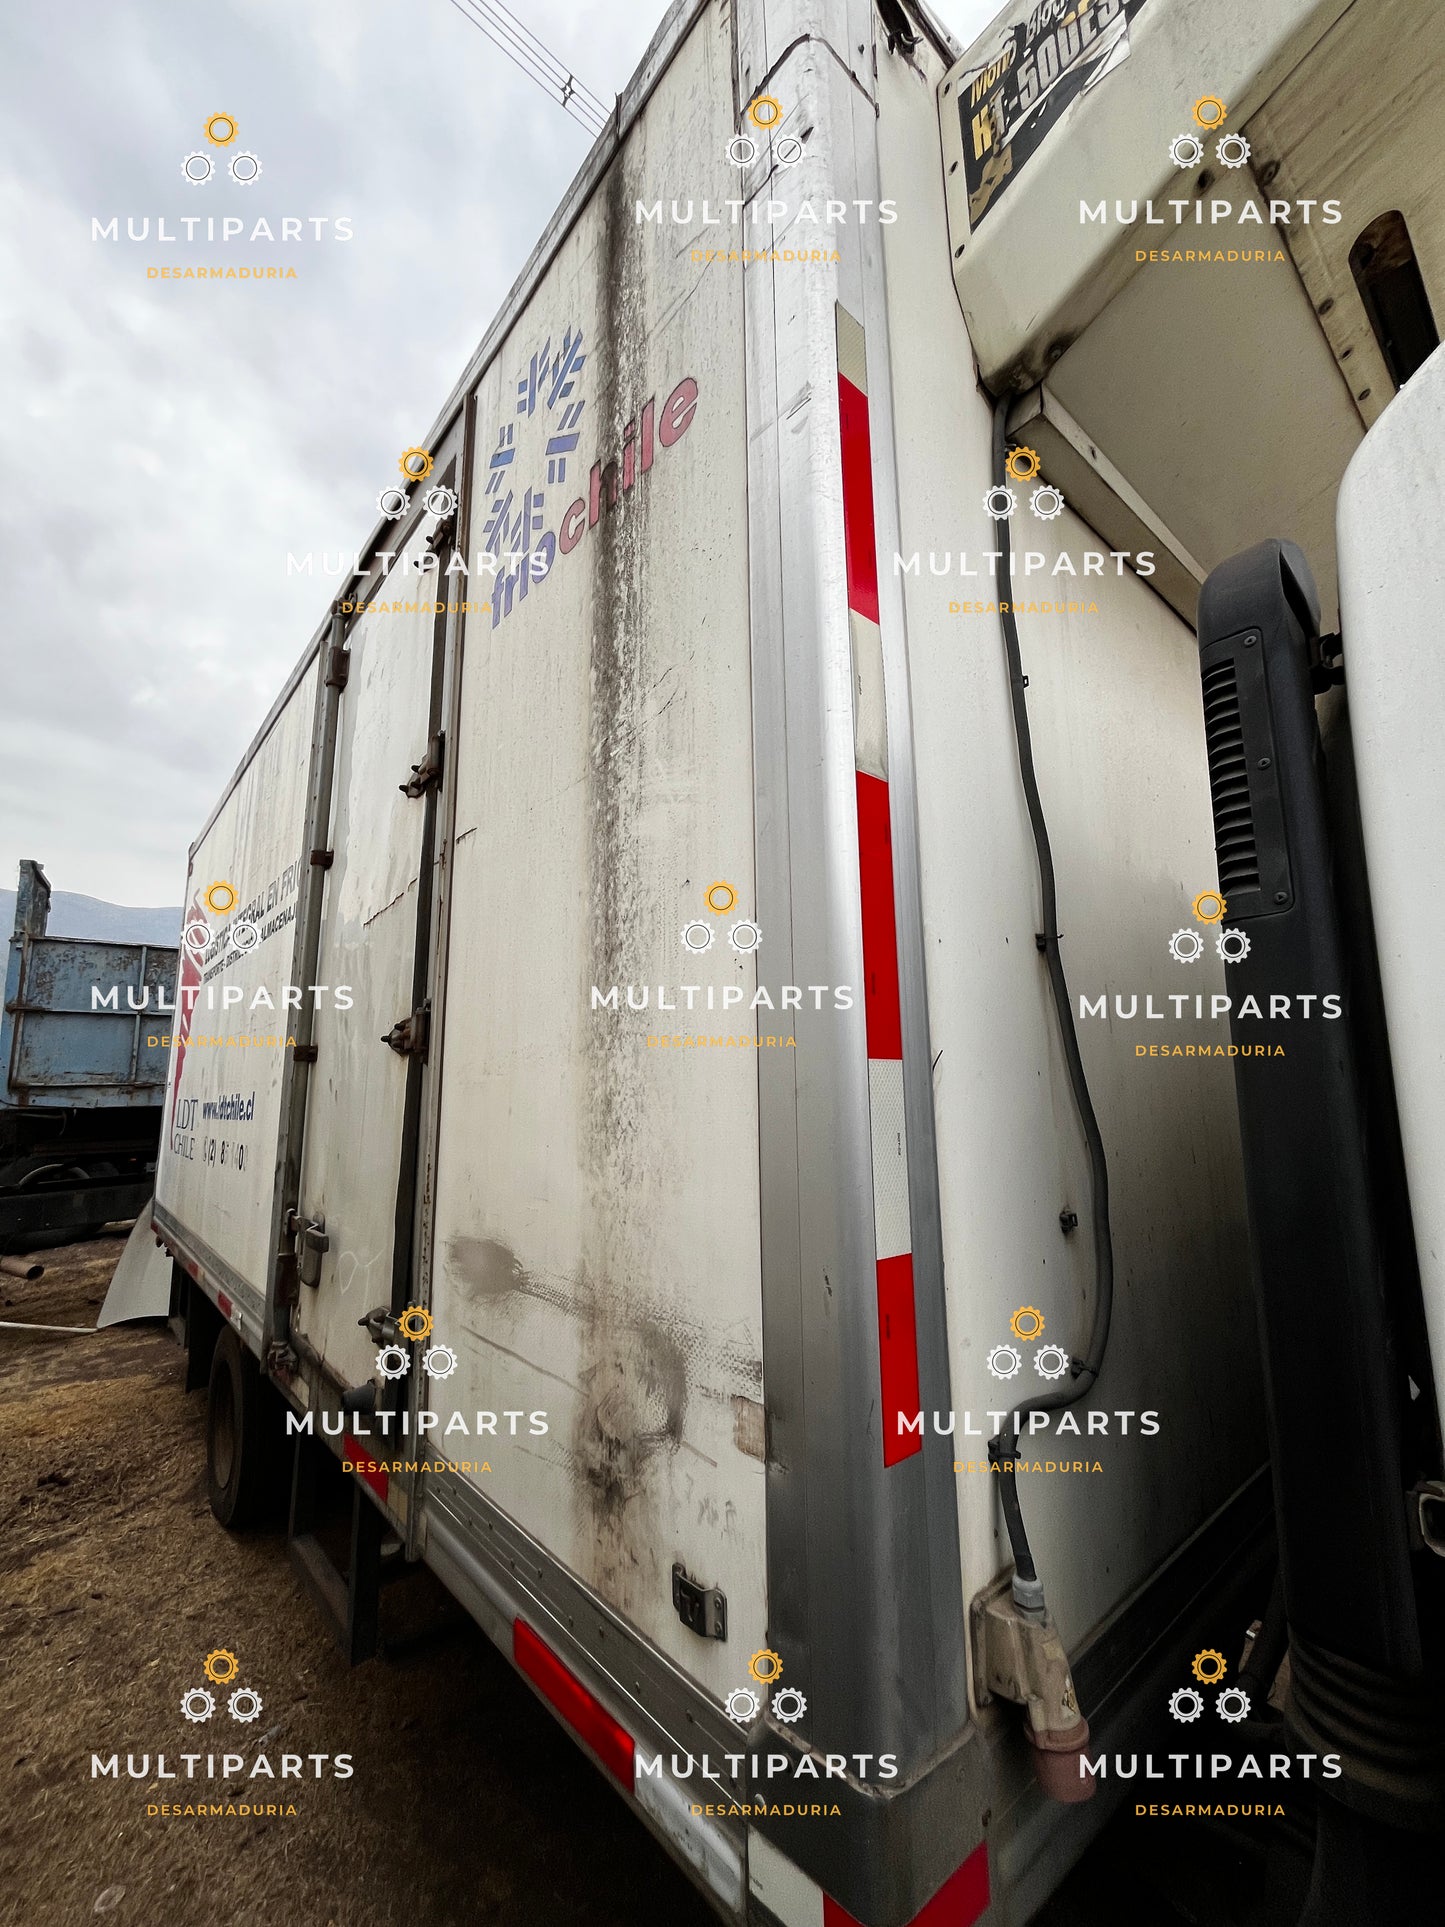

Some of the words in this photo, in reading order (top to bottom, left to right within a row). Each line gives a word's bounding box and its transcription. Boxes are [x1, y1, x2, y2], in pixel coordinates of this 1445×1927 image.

[175, 1098, 198, 1131] LDT
[202, 1091, 255, 1121] www.ldtchile.cl
[173, 1133, 195, 1161] CHILE
